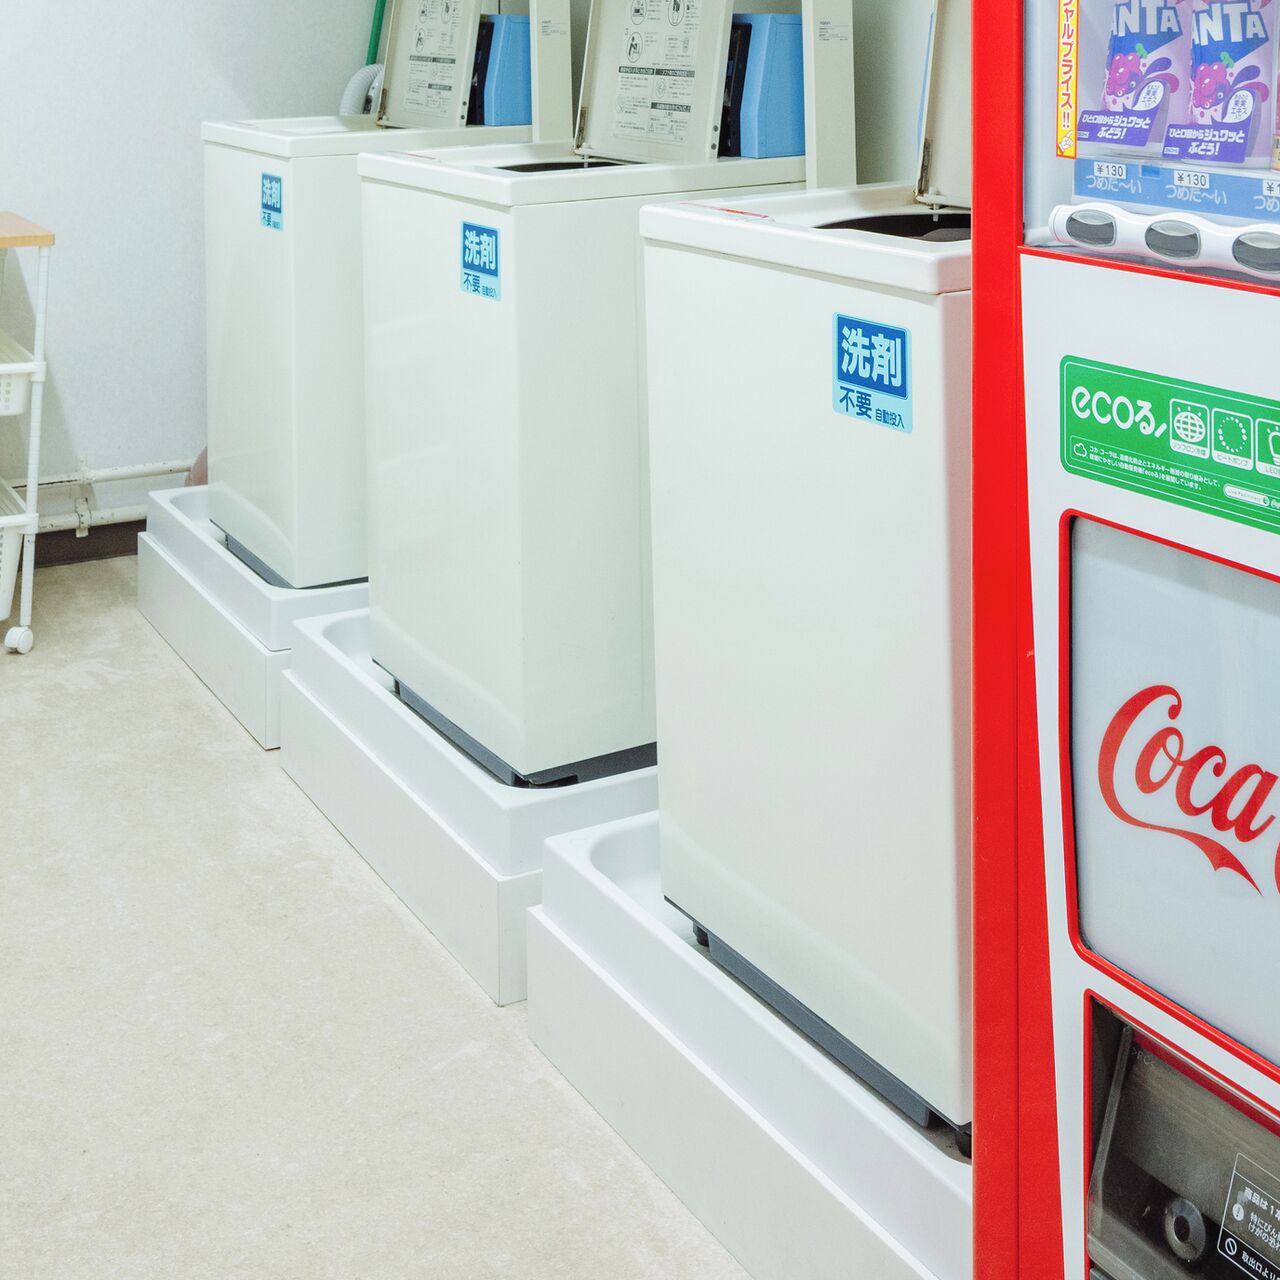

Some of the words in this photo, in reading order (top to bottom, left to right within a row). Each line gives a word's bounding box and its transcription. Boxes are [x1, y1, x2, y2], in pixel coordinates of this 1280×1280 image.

[262, 178, 281, 209] 洗剤
[464, 229, 496, 270] 洗剤
[463, 272, 481, 293] 不要
[841, 325, 902, 387] 洗剤
[840, 386, 872, 419] 不要
[875, 408, 905, 429] 自動投入
